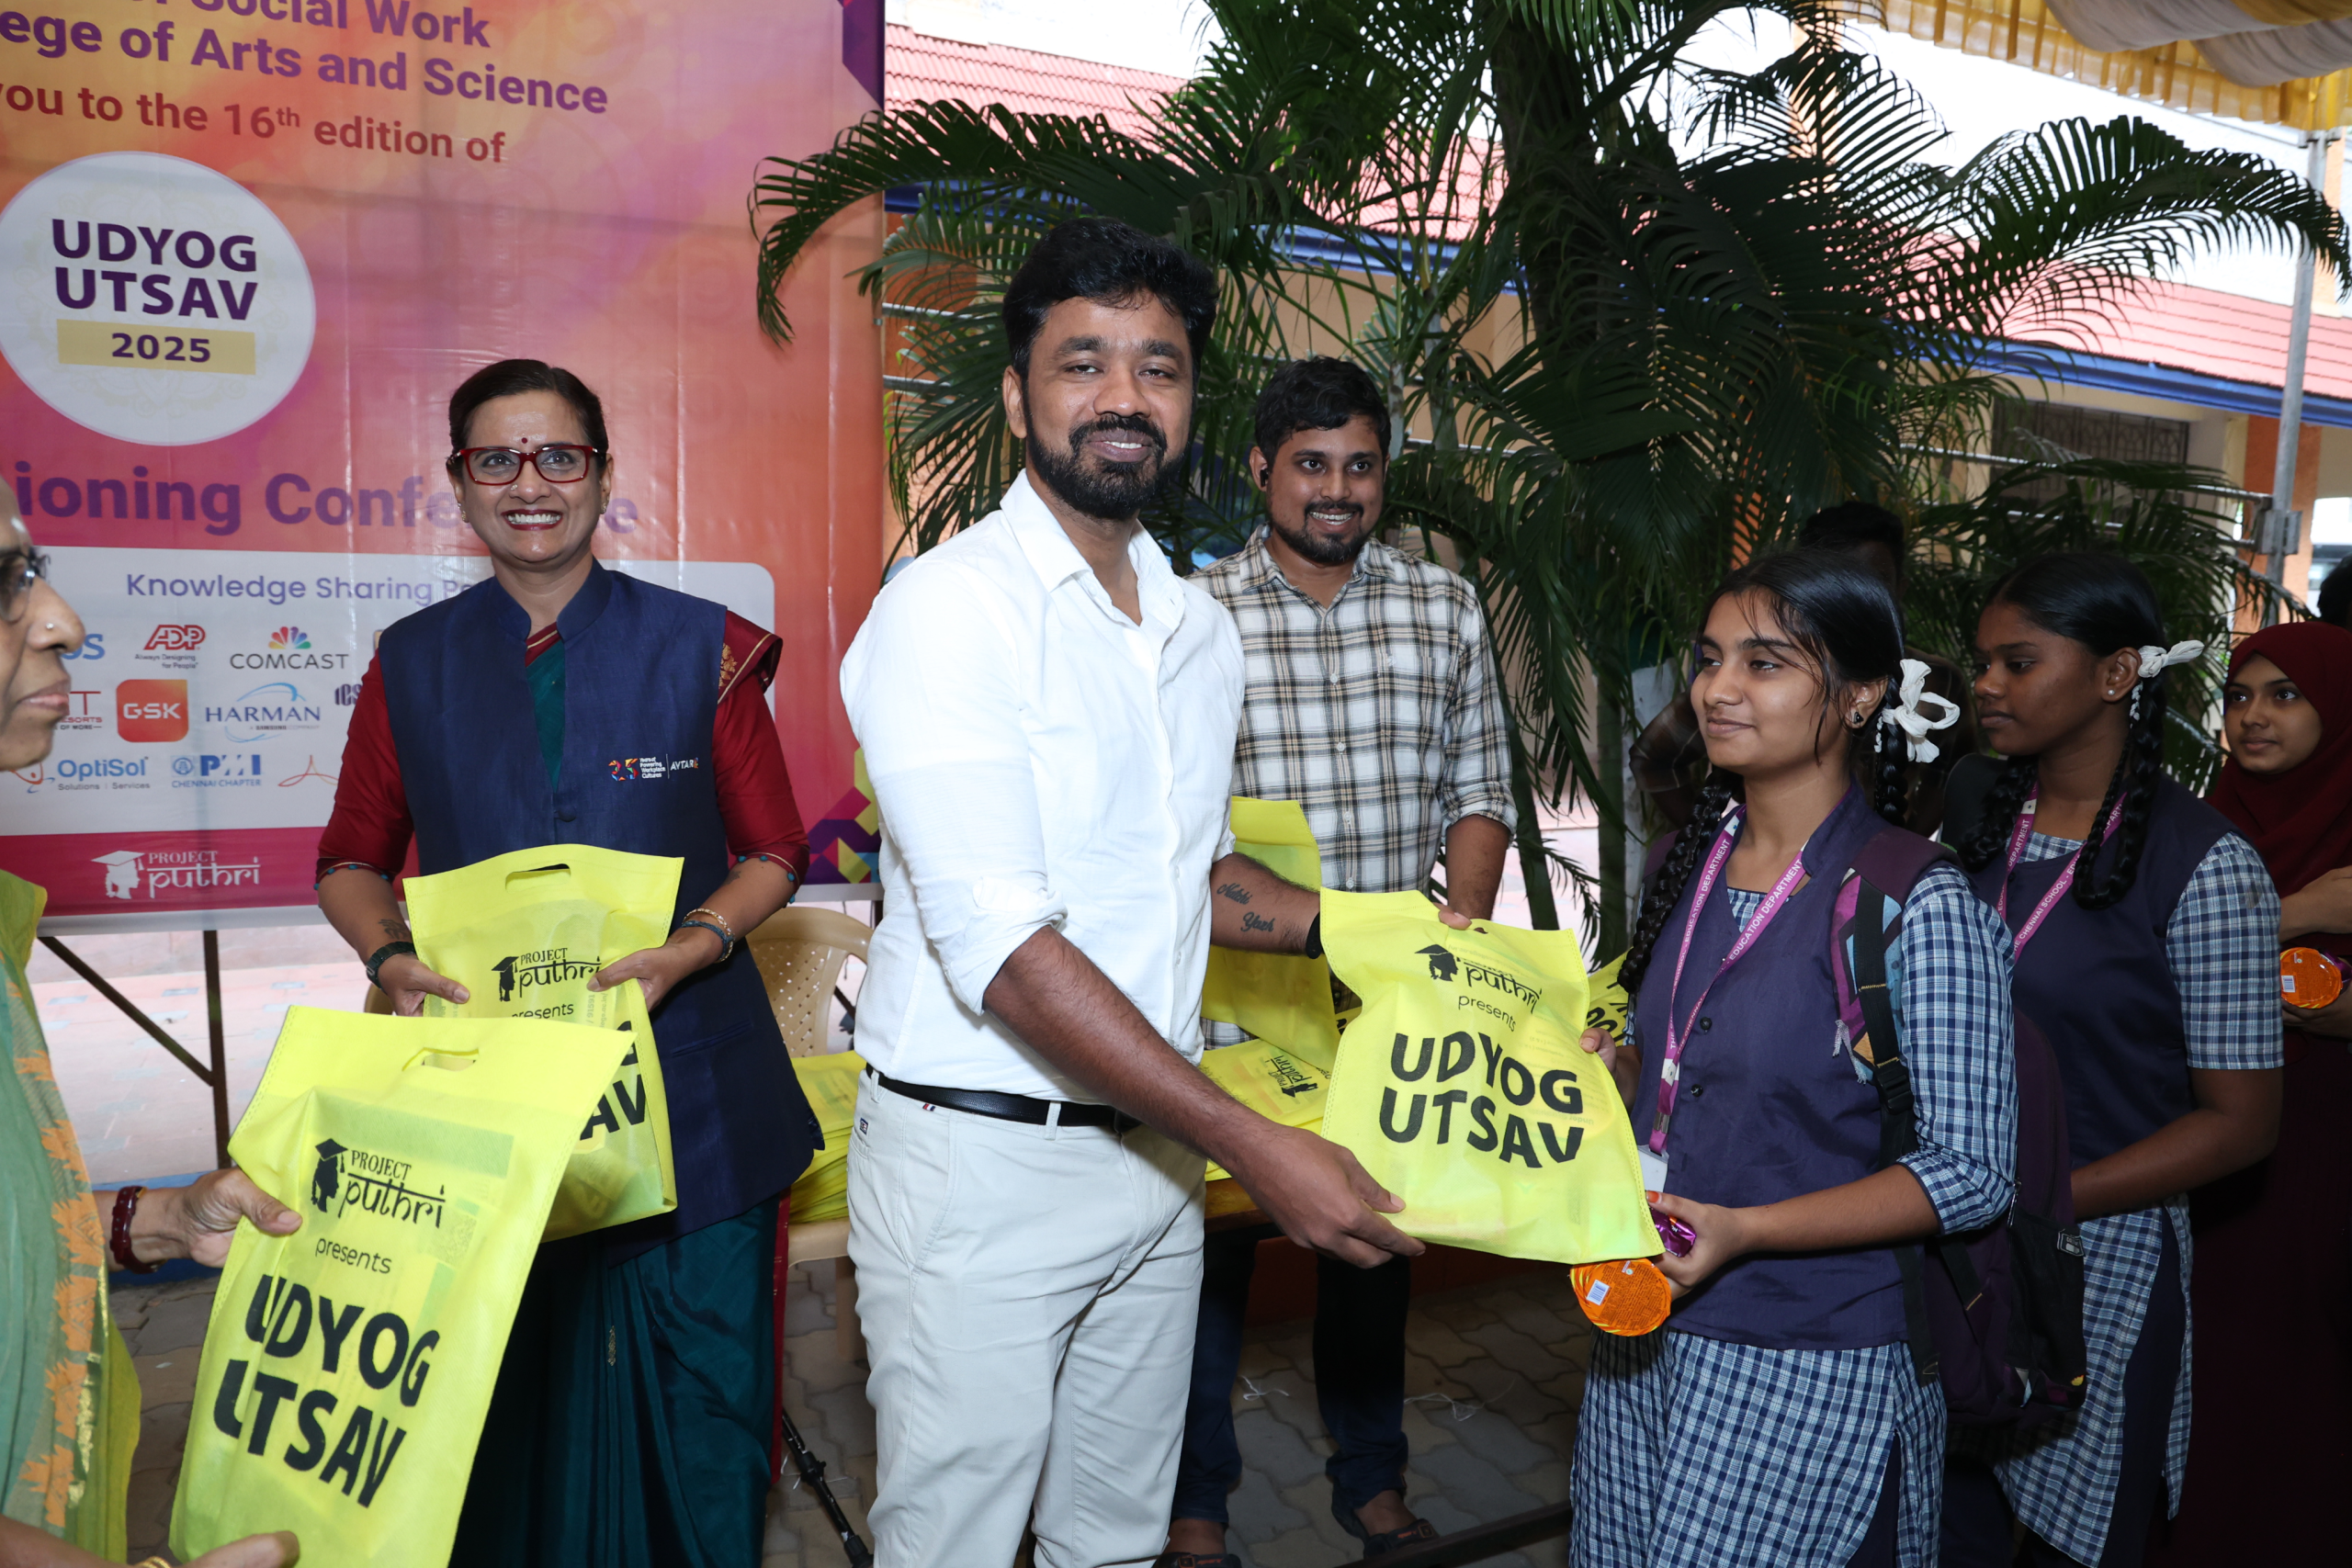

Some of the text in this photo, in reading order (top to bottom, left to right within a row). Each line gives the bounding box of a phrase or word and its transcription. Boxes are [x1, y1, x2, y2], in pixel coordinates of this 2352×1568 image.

[191, 0, 492, 48] ocial Work
[119, 20, 175, 62] of
[190, 28, 302, 77] Arts
[318, 51, 407, 91] and
[424, 57, 607, 114] Science
[0, 84, 505, 163] ou to the 16th edition of
[51, 218, 258, 273] UDYOG
[54, 266, 258, 321] UTSAV
[110, 332, 211, 363] 2025
[127, 573, 306, 604] Knowledge
[317, 577, 433, 607] Sharing
[143, 624, 206, 650] ADP
[135, 654, 196, 662] Always Designing
[230, 653, 349, 670] COMCAST
[122, 703, 182, 719] GSK
[205, 706, 321, 723] HARMAN
[57, 759, 146, 782] OptiSol
[172, 779, 261, 788] CHENNAI CHAPTER
[149, 851, 219, 864] PROJECT
[2008, 818, 2030, 867] DEPARTMENT
[147, 856, 260, 898] puthri
[1684, 893, 1704, 942] EDUCATION
[1702, 839, 1731, 892] DEPARTMENT
[1728, 911, 1763, 961] EDUCATION
[1760, 858, 1804, 914] DEPARTMENT
[2018, 908, 2044, 940] CHENNAI
[2041, 878, 2067, 908] SCHOOL
[520, 948, 568, 965] PROJECT
[518, 956, 603, 998] puthri
[512, 1003, 574, 1020] resents
[1458, 995, 1517, 1032] presents
[1390, 1031, 1583, 1114] UDYOG
[1379, 1086, 1585, 1168] UTSAV
[350, 1149, 412, 1180] PROJECT
[336, 1172, 446, 1229] puthri
[315, 1237, 392, 1274] presents
[244, 1273, 440, 1407] UDYOG
